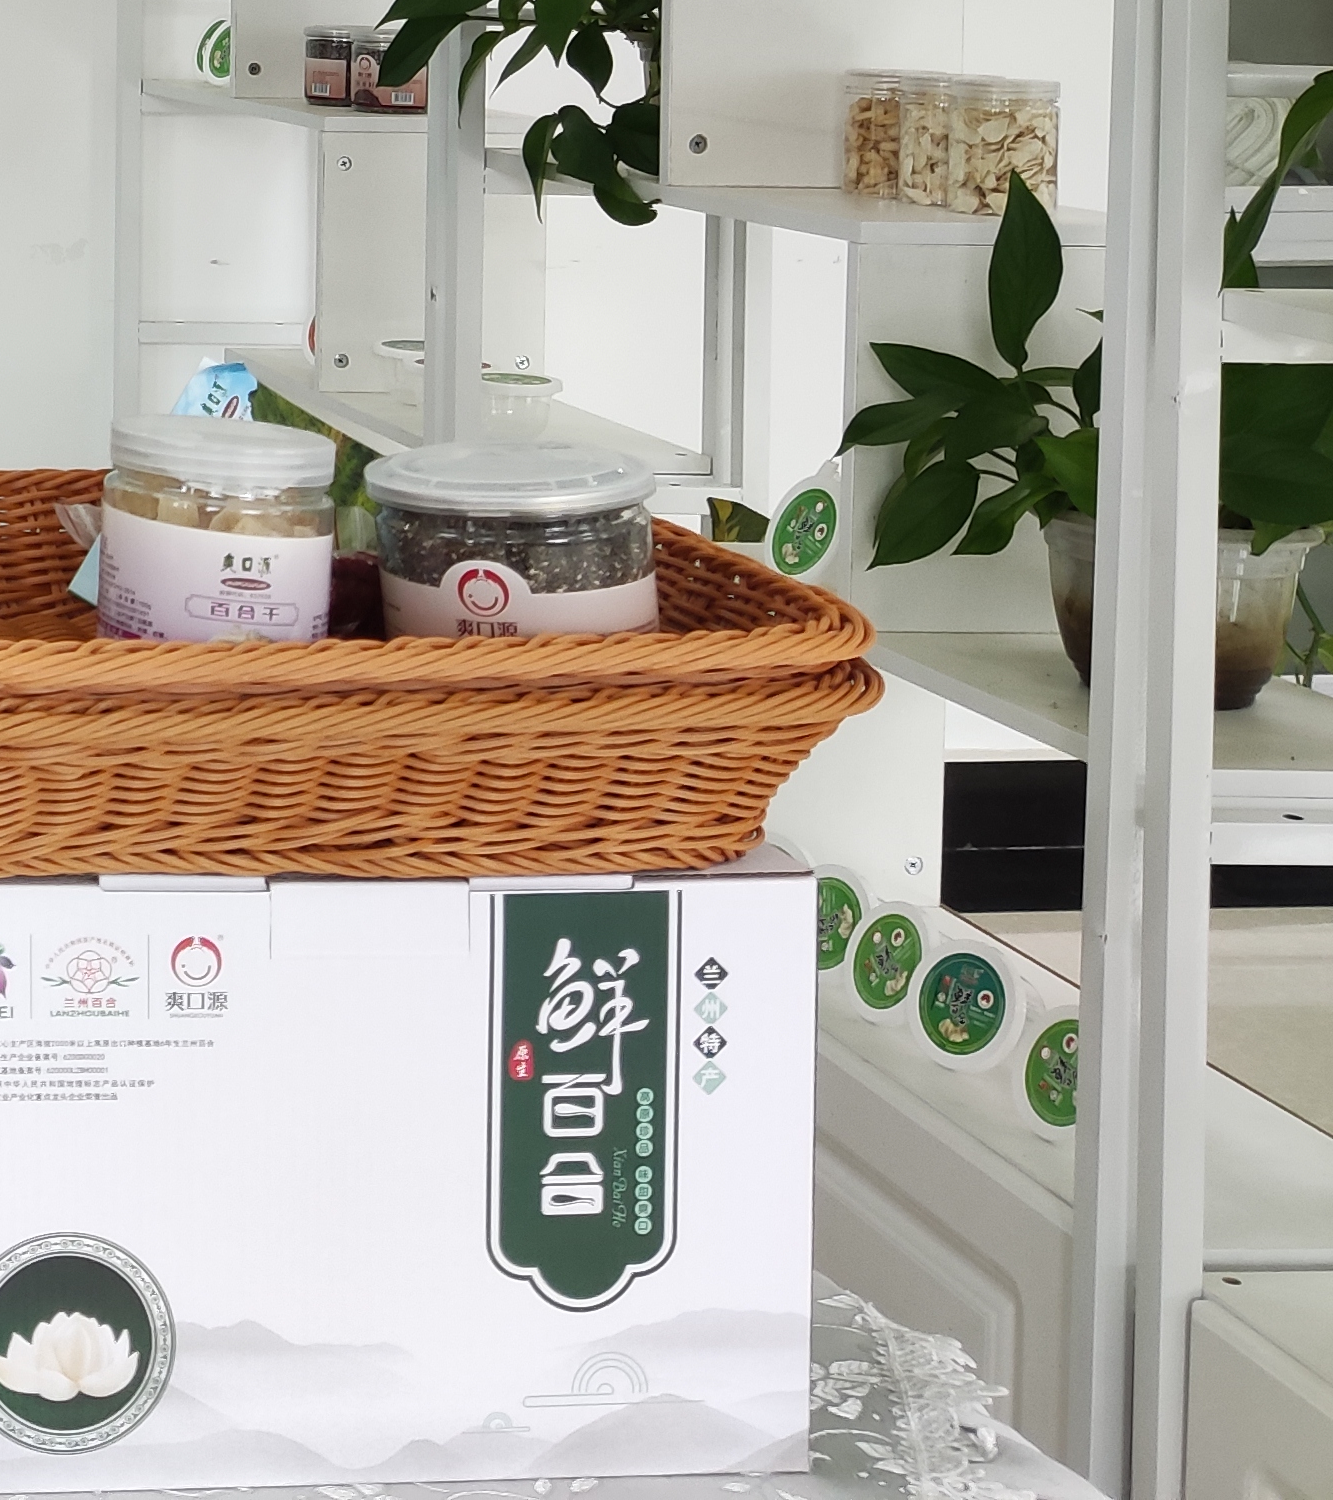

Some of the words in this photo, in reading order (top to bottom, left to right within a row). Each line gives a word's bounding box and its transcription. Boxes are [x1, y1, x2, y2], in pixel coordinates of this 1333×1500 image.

[220, 552, 272, 577] 爽口源
[210, 601, 281, 621] 百合干
[455, 618, 519, 638] 爽口源
[64, 997, 117, 1009] 兰州百合
[165, 991, 229, 1012] 爽口源
[50, 1010, 130, 1018] LANZHOUBAIHE
[694, 959, 728, 1092] 兰州特产
[536, 938, 650, 1216] 鲜百合
